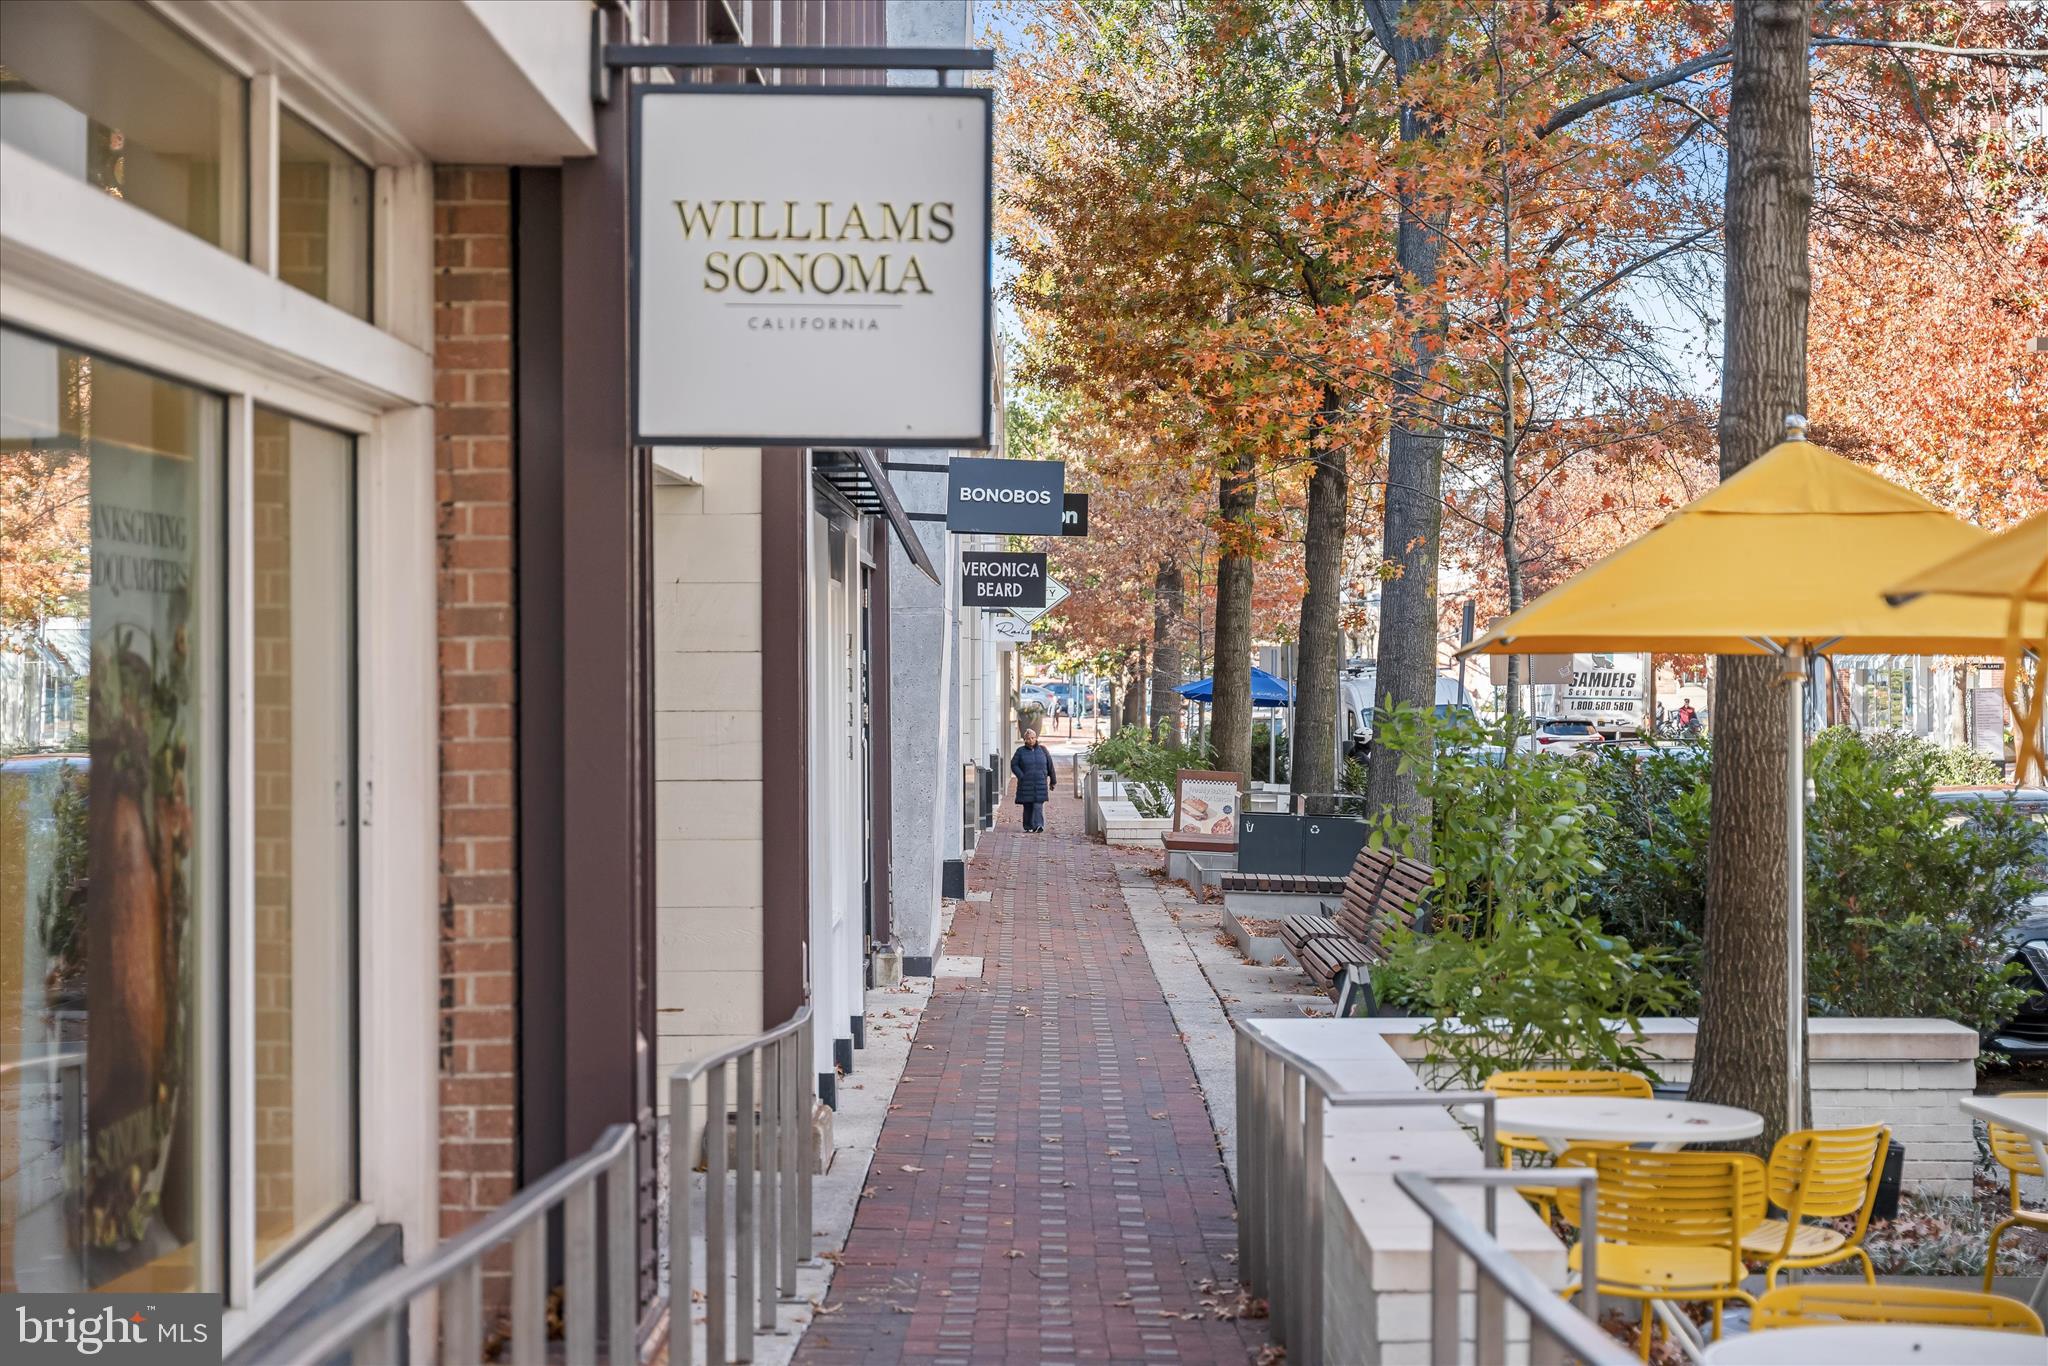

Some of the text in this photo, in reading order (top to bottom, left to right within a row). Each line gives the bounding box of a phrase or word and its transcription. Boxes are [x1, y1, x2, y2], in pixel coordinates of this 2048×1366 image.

[672, 200, 955, 244] WILLIAMS
[703, 251, 935, 295] SONOMA
[747, 316, 880, 331] CALIFORNIA
[959, 487, 1051, 504] BONOBOS
[1061, 510, 1078, 524] n
[962, 561, 1040, 578] VERONICA
[977, 582, 1023, 597] BEARD
[995, 621, 1031, 638] Rails
[1568, 671, 1637, 688] SAMUELS
[1568, 688, 1613, 697] Seafood
[1570, 701, 1634, 711] 1.800.580.5810
